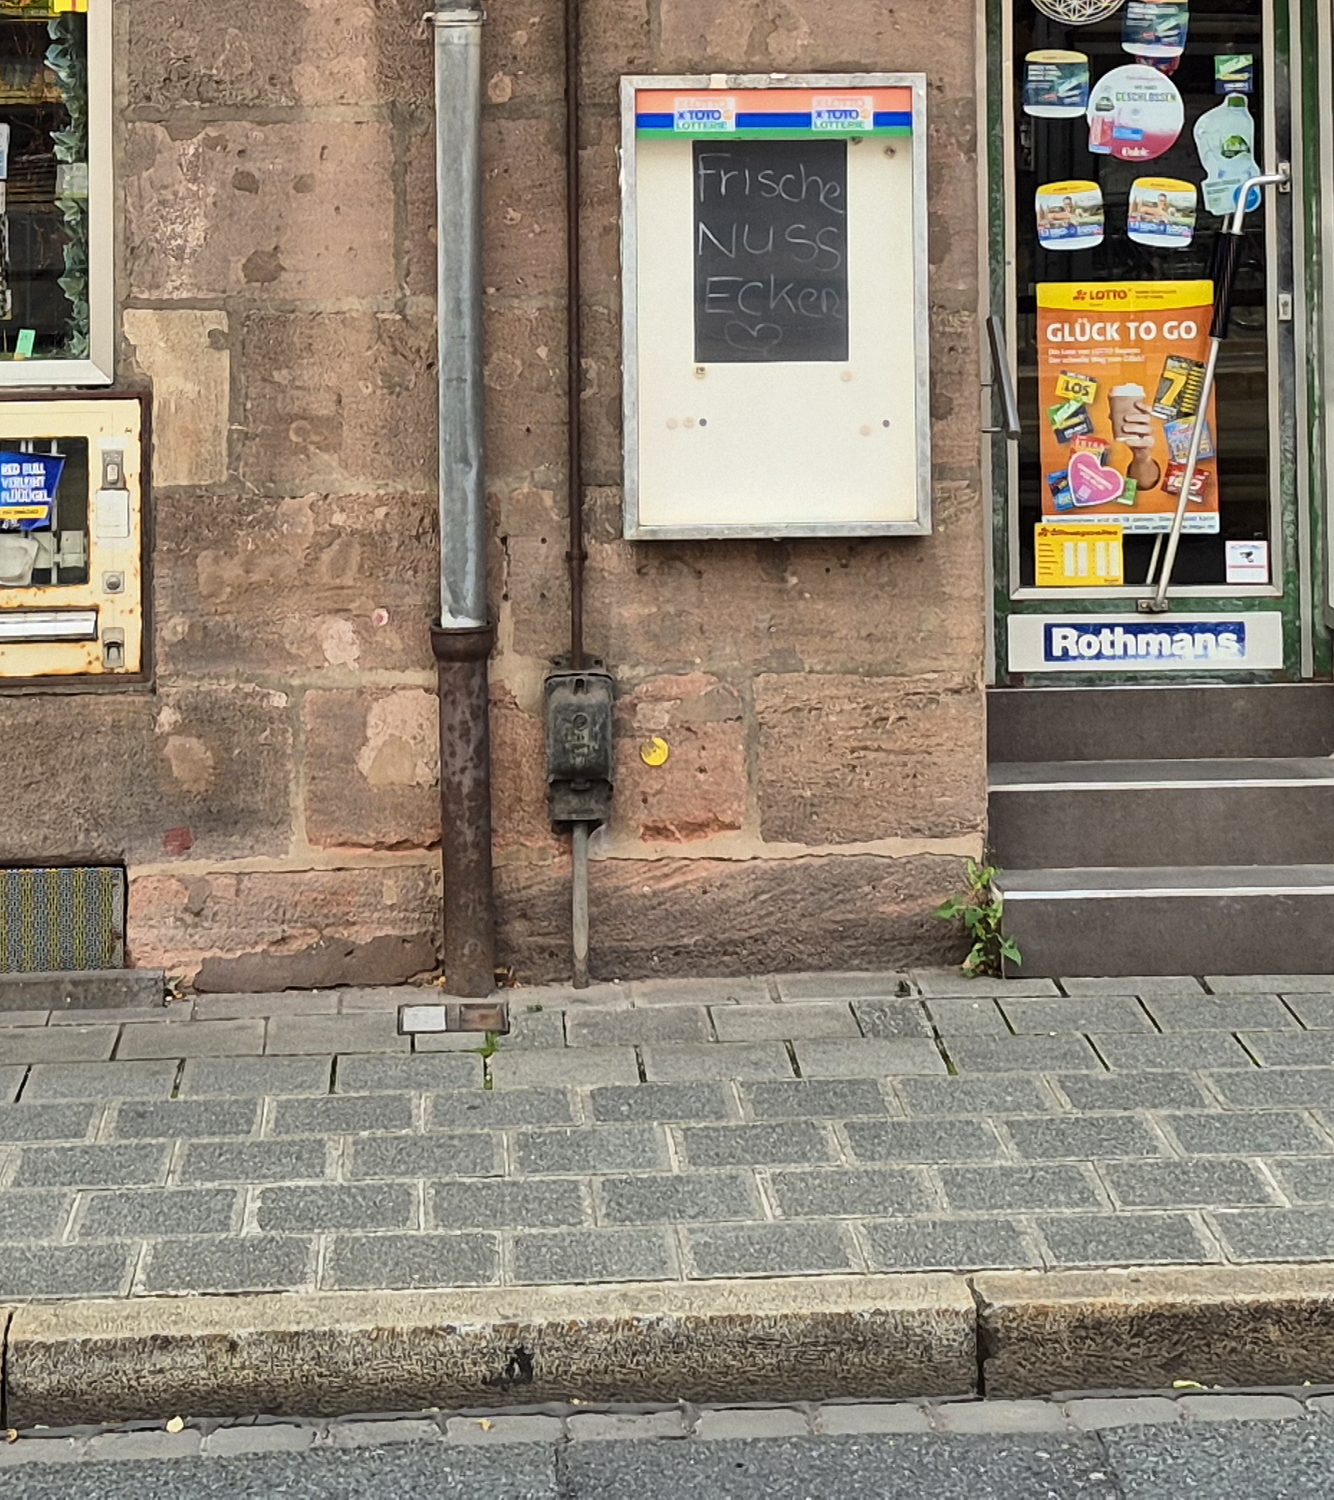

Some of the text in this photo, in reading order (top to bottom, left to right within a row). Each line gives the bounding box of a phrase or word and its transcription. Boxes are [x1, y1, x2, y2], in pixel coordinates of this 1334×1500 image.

[698, 153, 844, 214] Frische
[1089, 290, 1127, 300] LOTTO
[1046, 317, 1198, 342] GLÜCK TO GO
[1051, 627, 1241, 660] Rothmans
